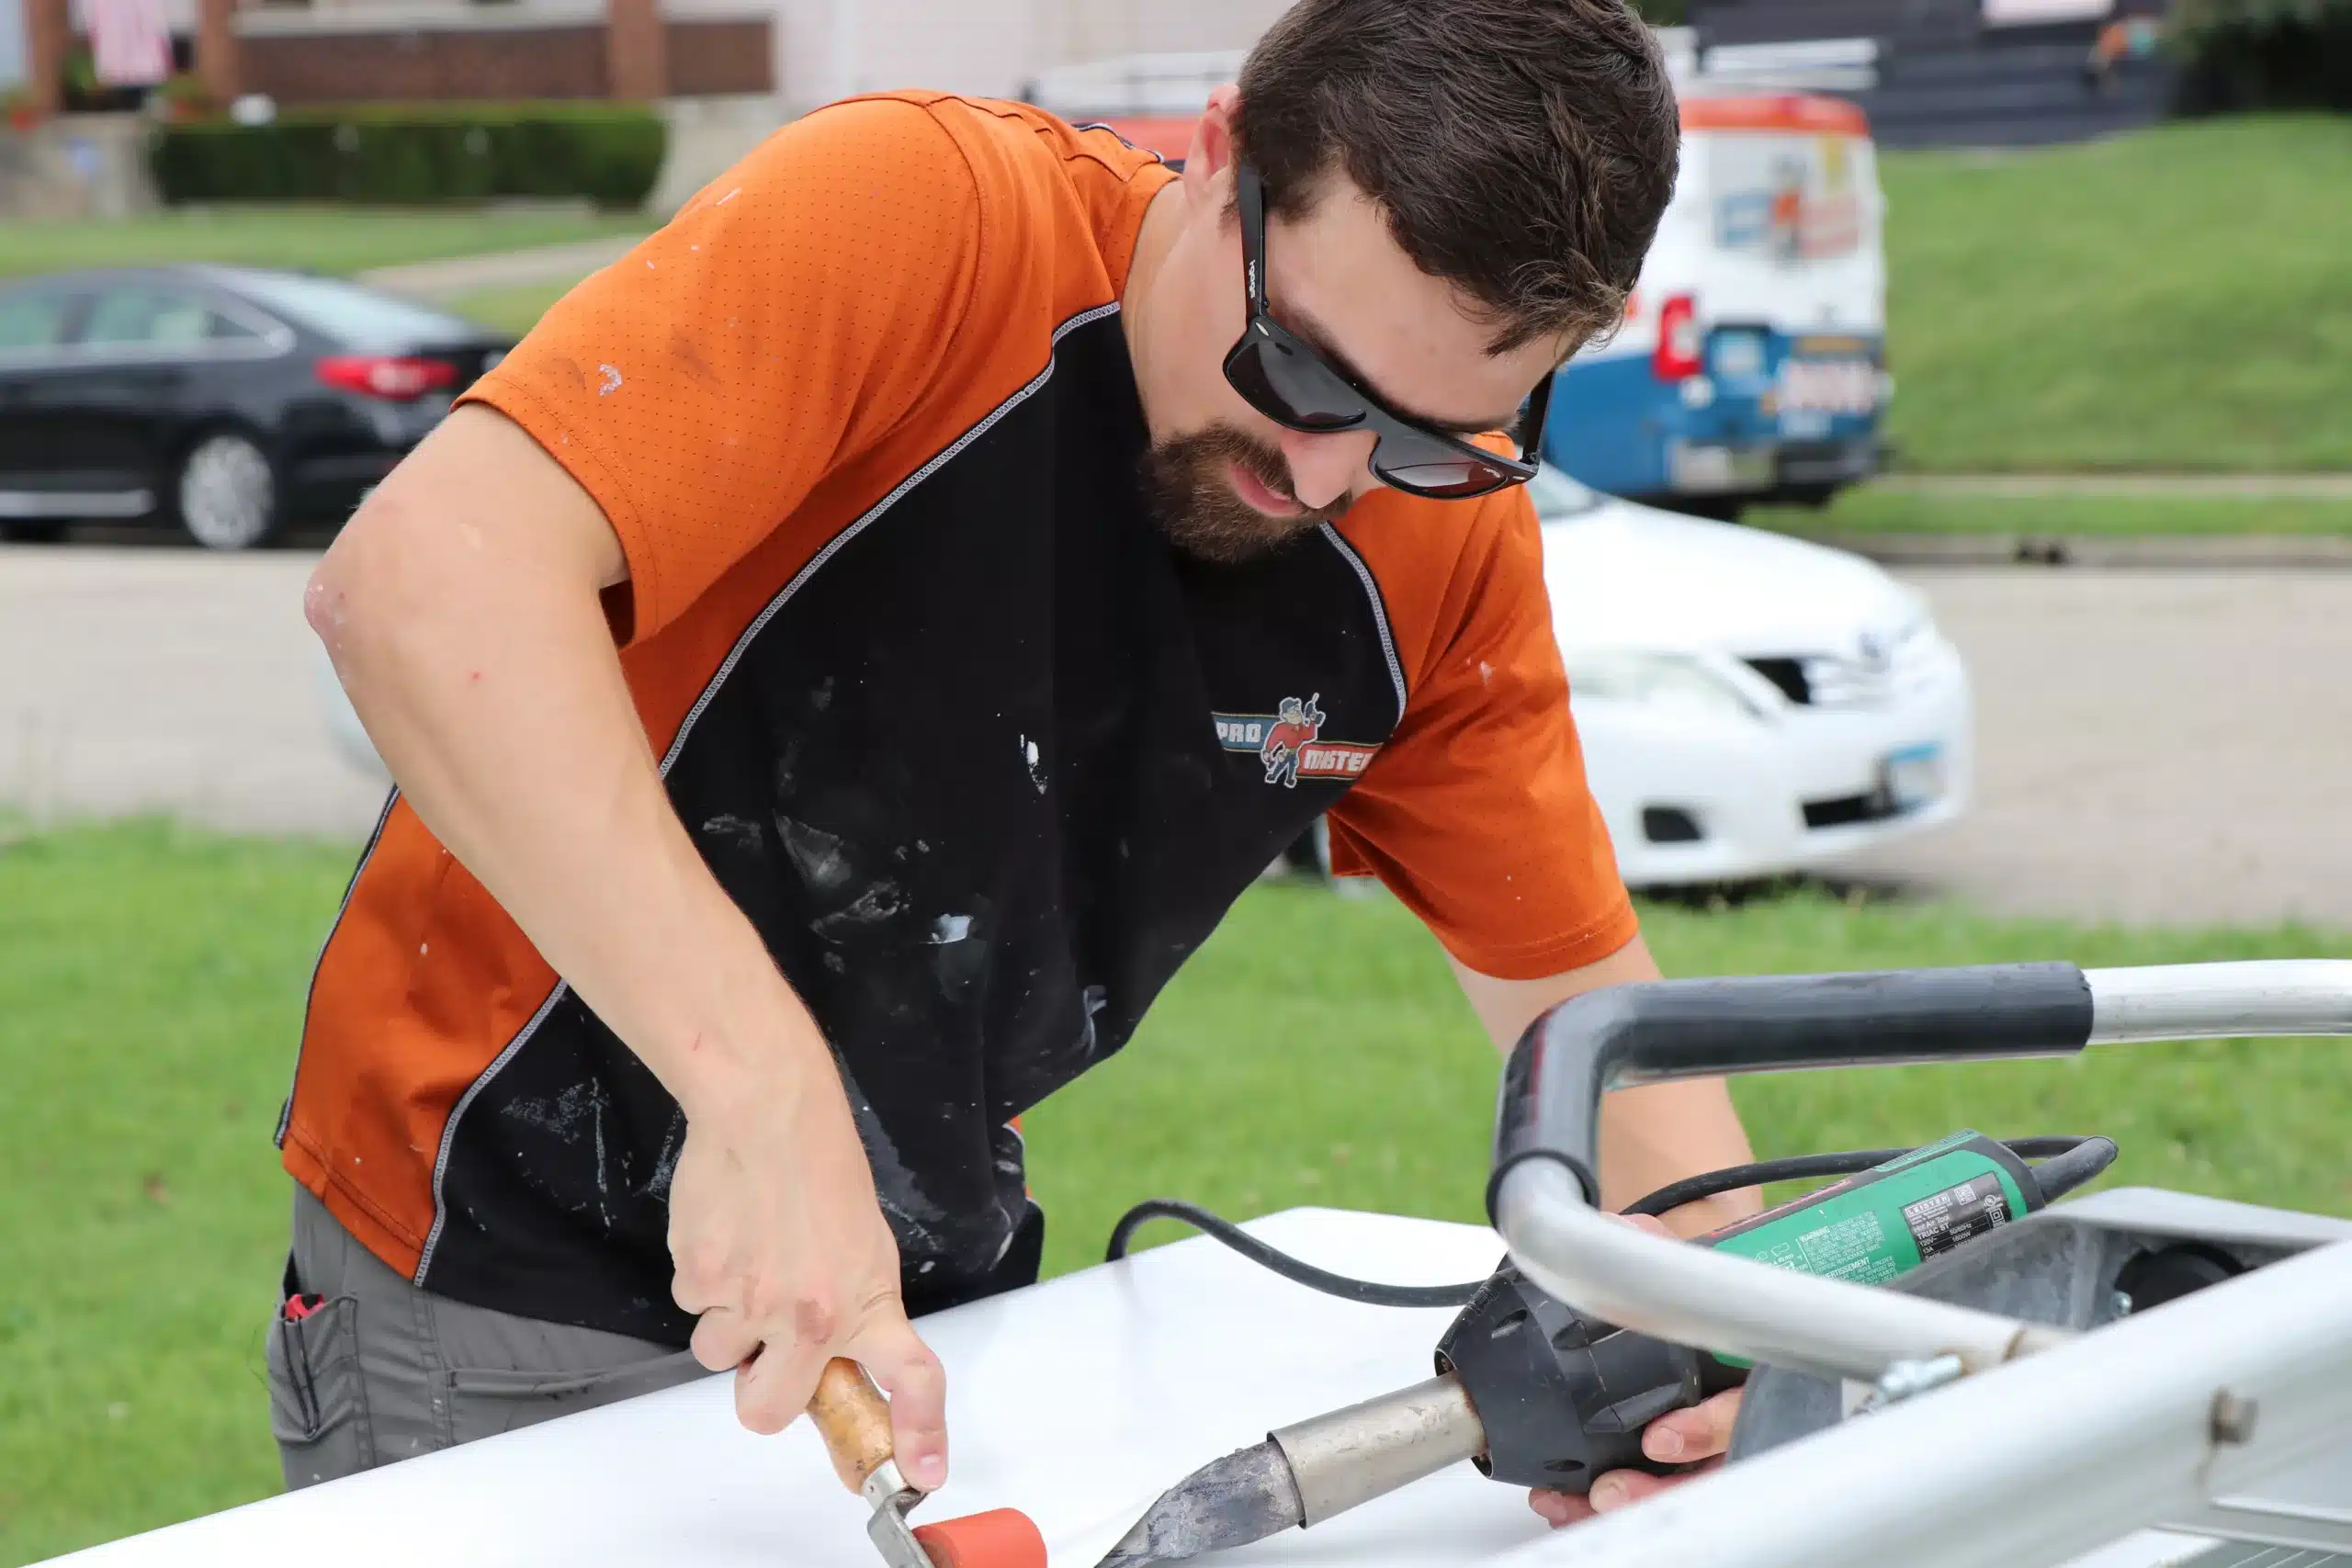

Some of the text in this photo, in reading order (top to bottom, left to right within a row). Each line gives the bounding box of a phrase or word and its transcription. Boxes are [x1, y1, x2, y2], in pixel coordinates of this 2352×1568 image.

[1216, 721, 1261, 743] PRO
[1926, 1219, 1936, 1227] Air
[1936, 1213, 1950, 1224] Tool
[1917, 1222, 1951, 1240] TRIAC ST
[1950, 1222, 1973, 1235] 50/60Hz
[1923, 1246, 1934, 1255] 13A
